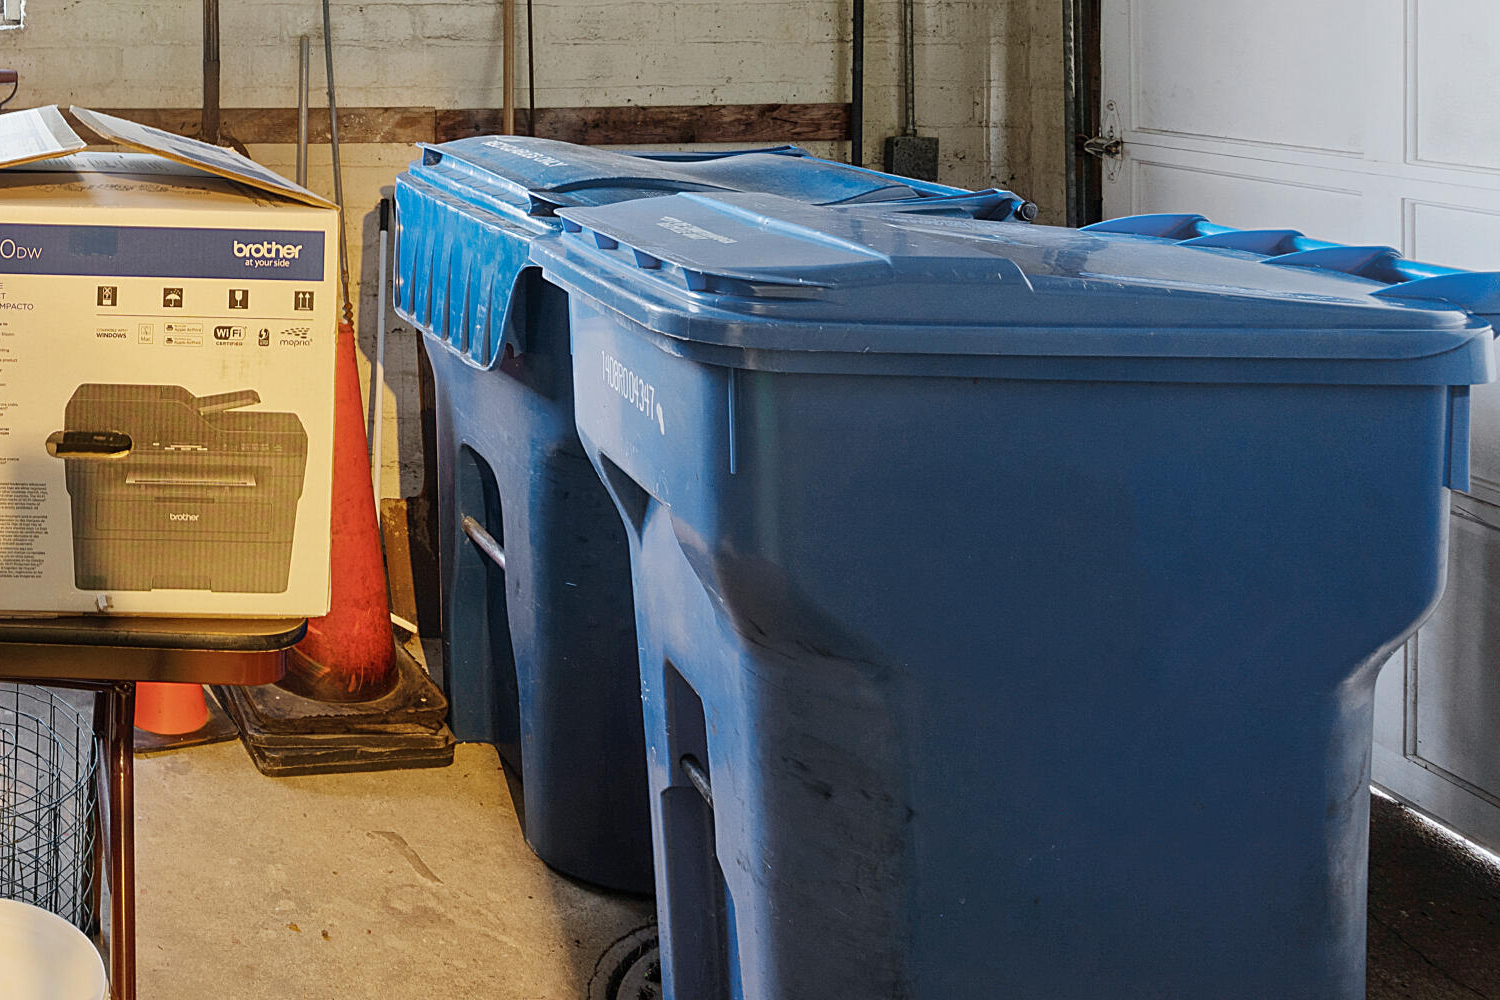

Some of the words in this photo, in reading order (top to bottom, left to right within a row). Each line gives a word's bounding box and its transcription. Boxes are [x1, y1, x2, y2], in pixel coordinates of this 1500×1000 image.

[233, 240, 302, 259] brother
[254, 260, 274, 268] your
[274, 259, 290, 268] side
[280, 339, 310, 347] mopria
[170, 513, 200, 521] brother
